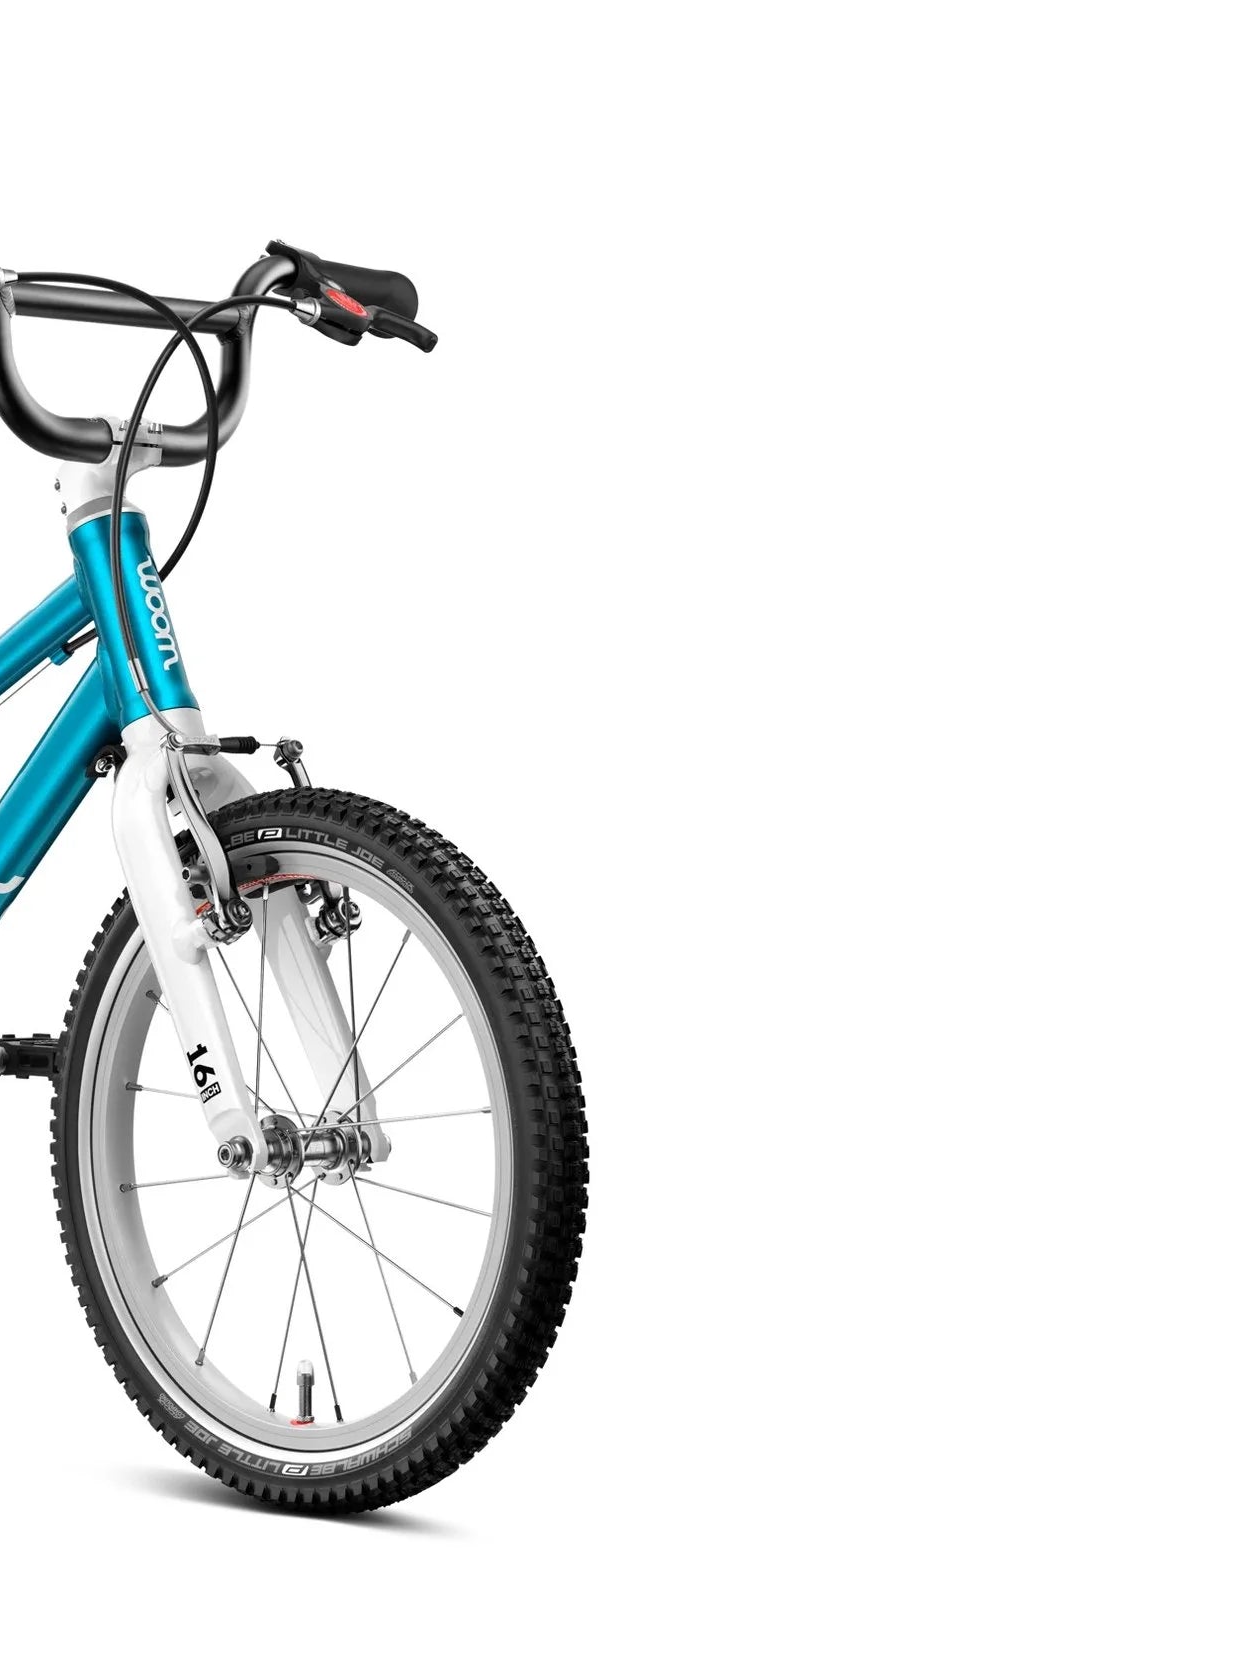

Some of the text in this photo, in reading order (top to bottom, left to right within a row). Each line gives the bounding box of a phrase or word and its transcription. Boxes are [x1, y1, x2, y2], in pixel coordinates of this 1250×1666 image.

[136, 555, 179, 671] woom
[285, 827, 349, 848] LITTLE
[351, 847, 385, 869] JOE
[186, 1043, 221, 1103] 16 INCH
[183, 1420, 412, 1476] SCHWALBE LITTLE JOE
